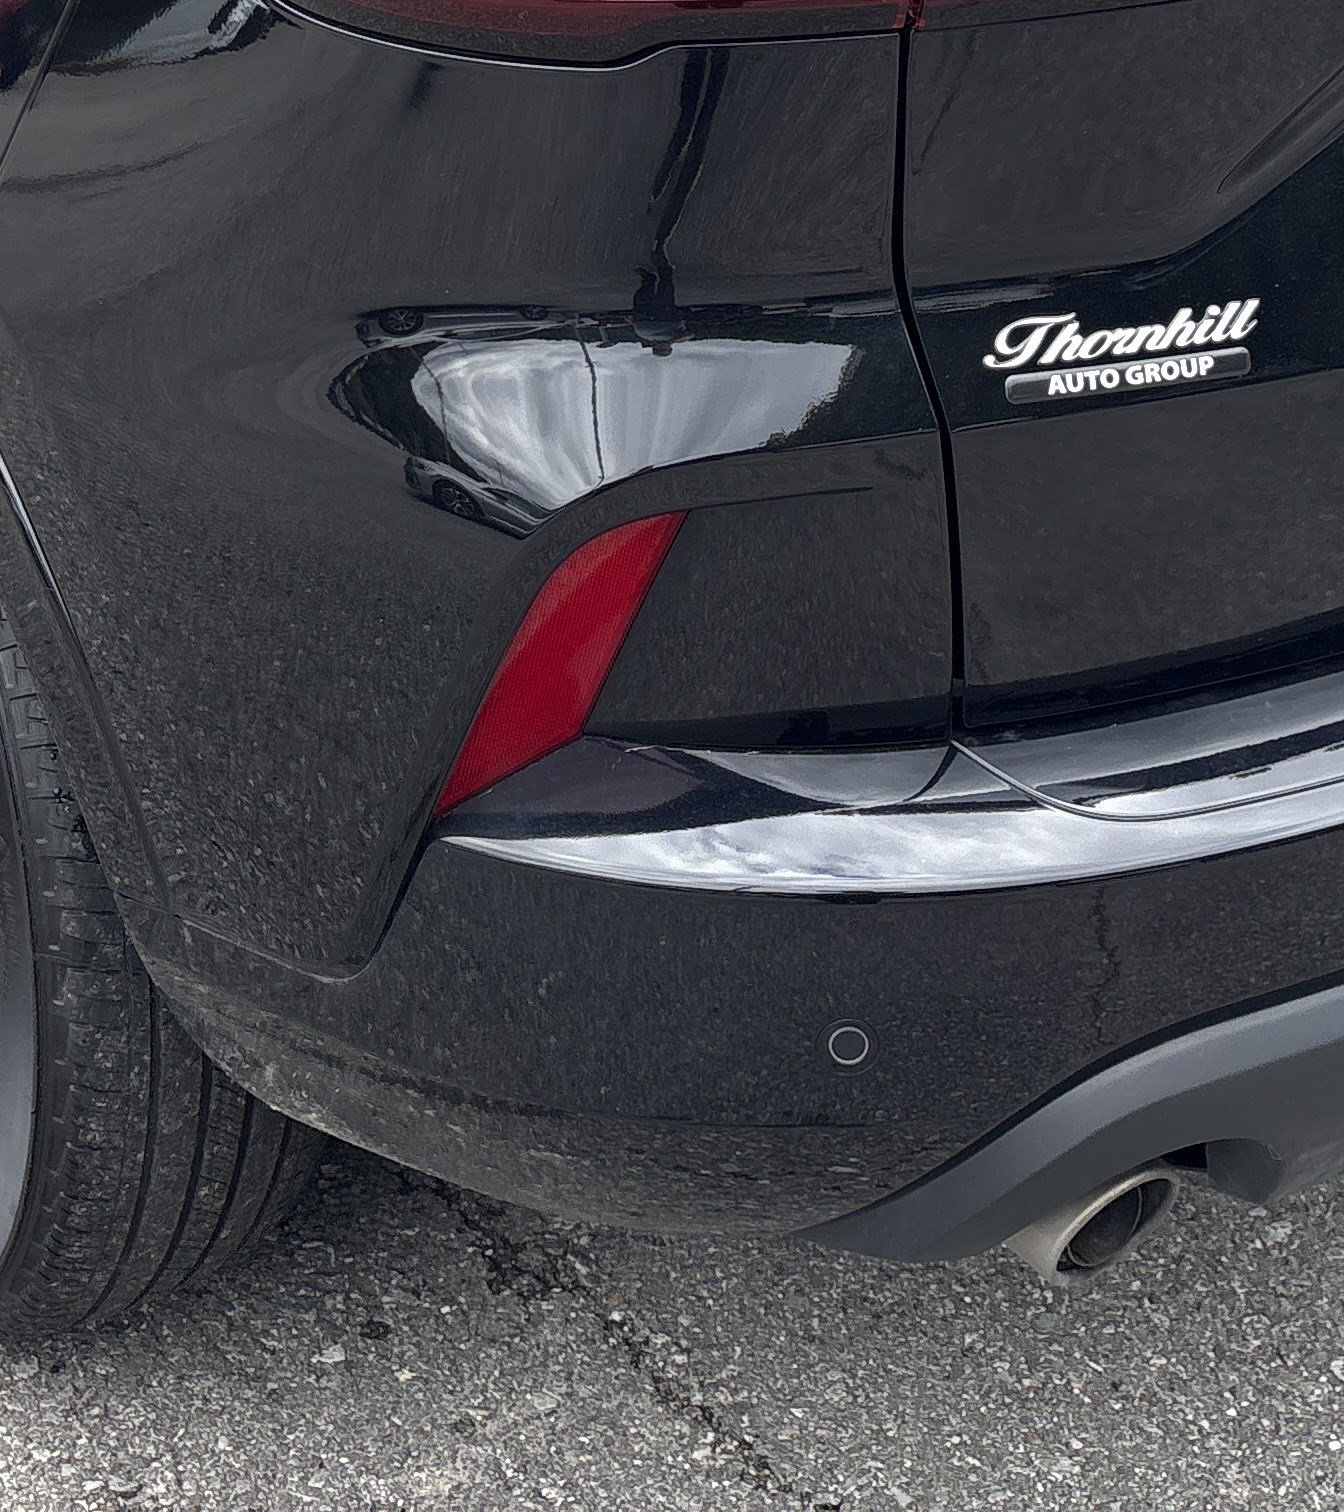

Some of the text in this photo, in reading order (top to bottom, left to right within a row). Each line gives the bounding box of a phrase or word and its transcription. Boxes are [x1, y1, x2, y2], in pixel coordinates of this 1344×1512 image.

[983, 298, 1261, 369] Thornhill
[1047, 355, 1215, 396] AUTO GROUP
